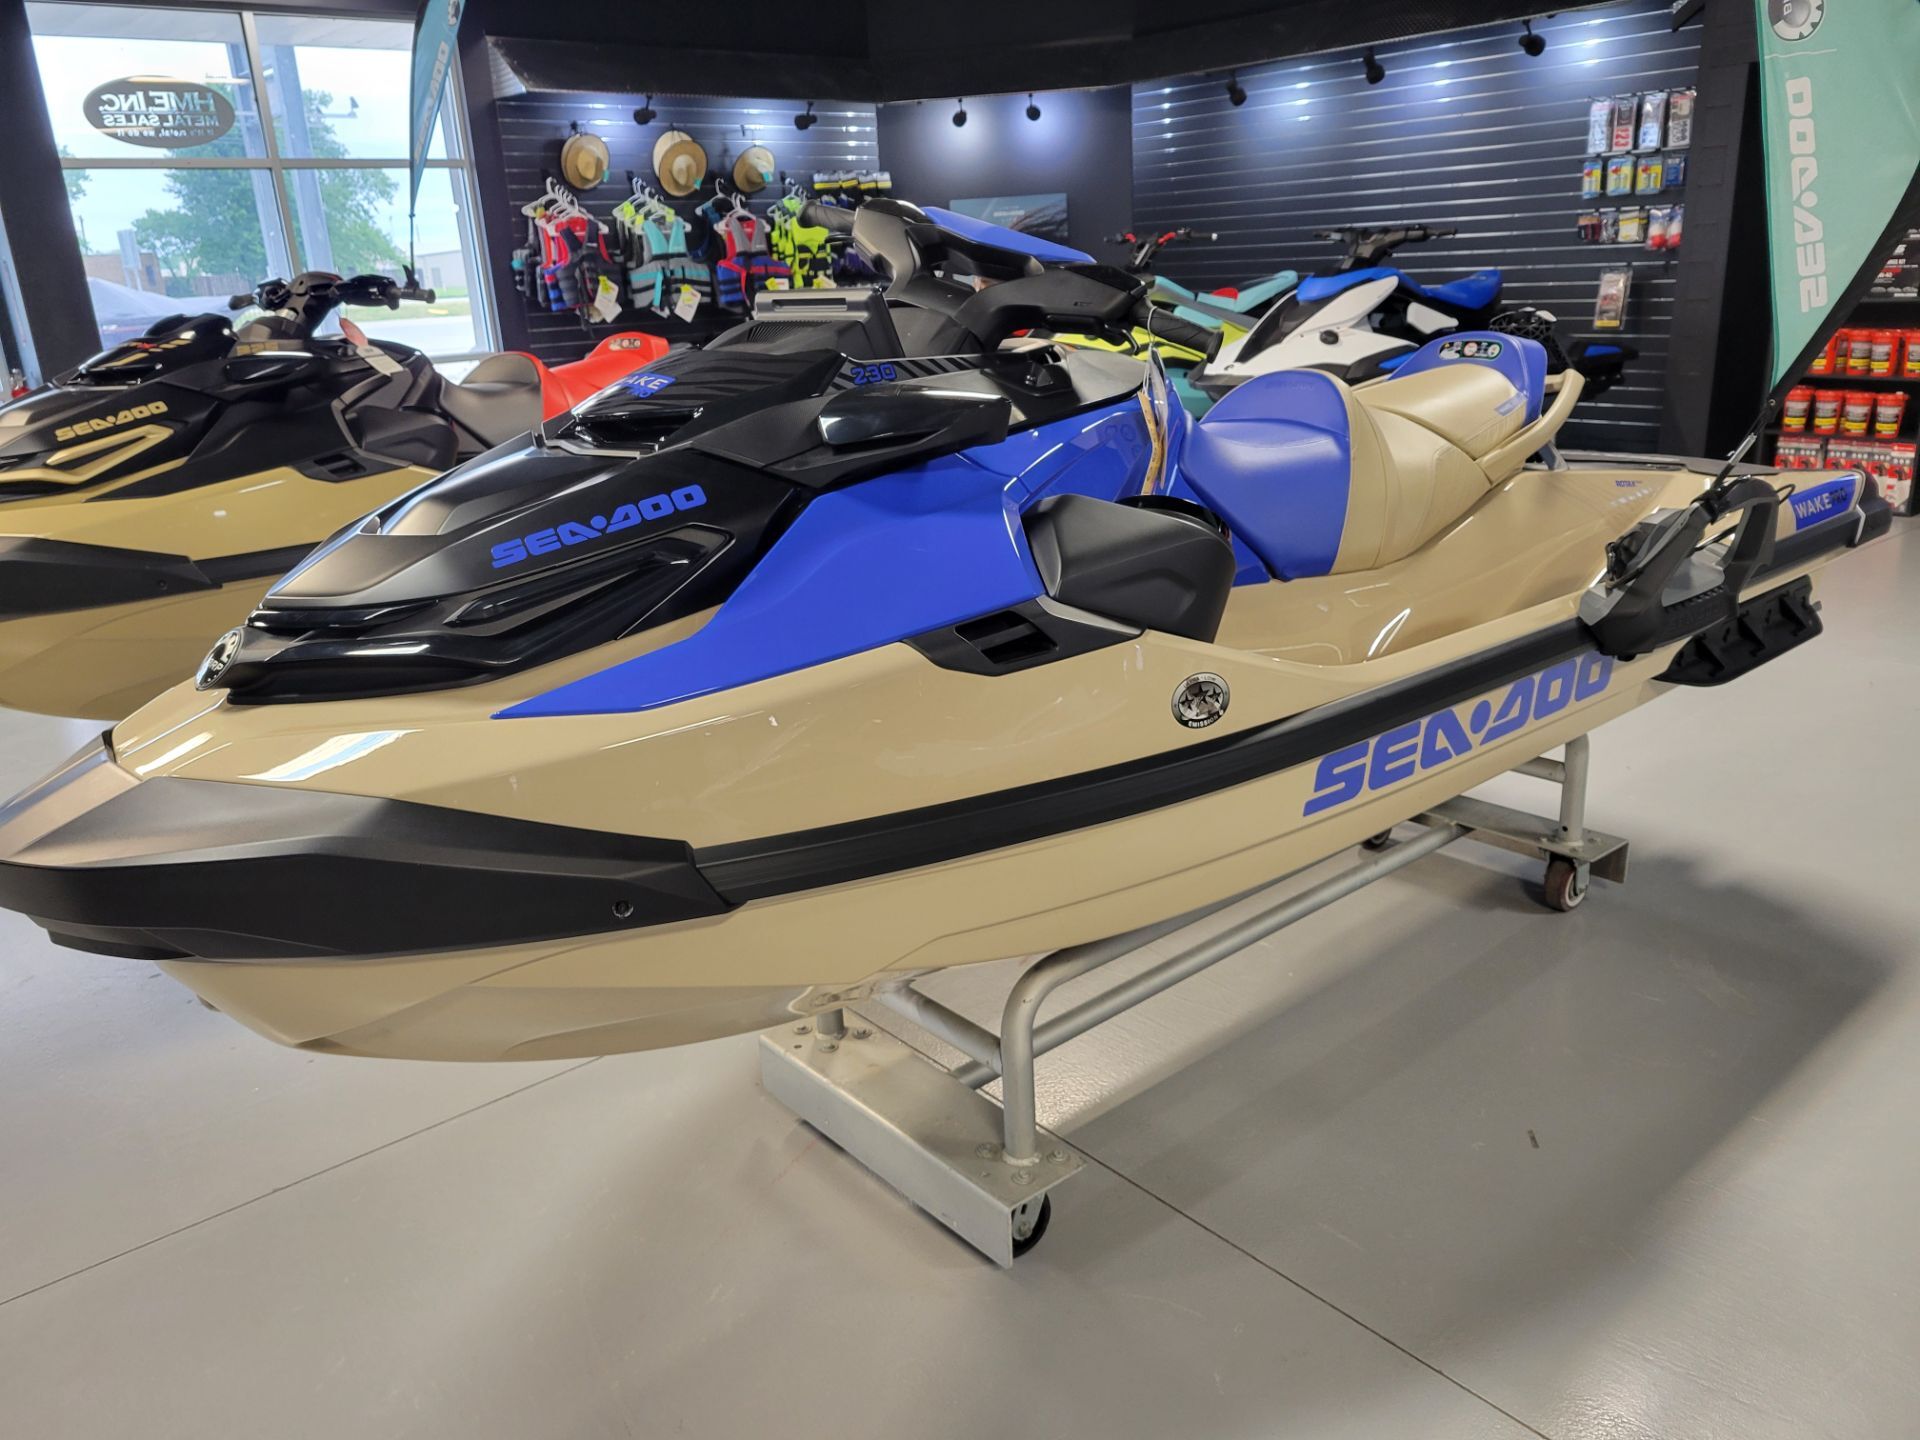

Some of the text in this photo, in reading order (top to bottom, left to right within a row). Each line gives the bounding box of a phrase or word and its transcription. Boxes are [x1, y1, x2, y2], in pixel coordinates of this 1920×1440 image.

[622, 375, 669, 390] AKE
[850, 362, 897, 385] 230
[1795, 492, 1832, 519] WAKE
[1188, 714, 1219, 728] EMISSION
